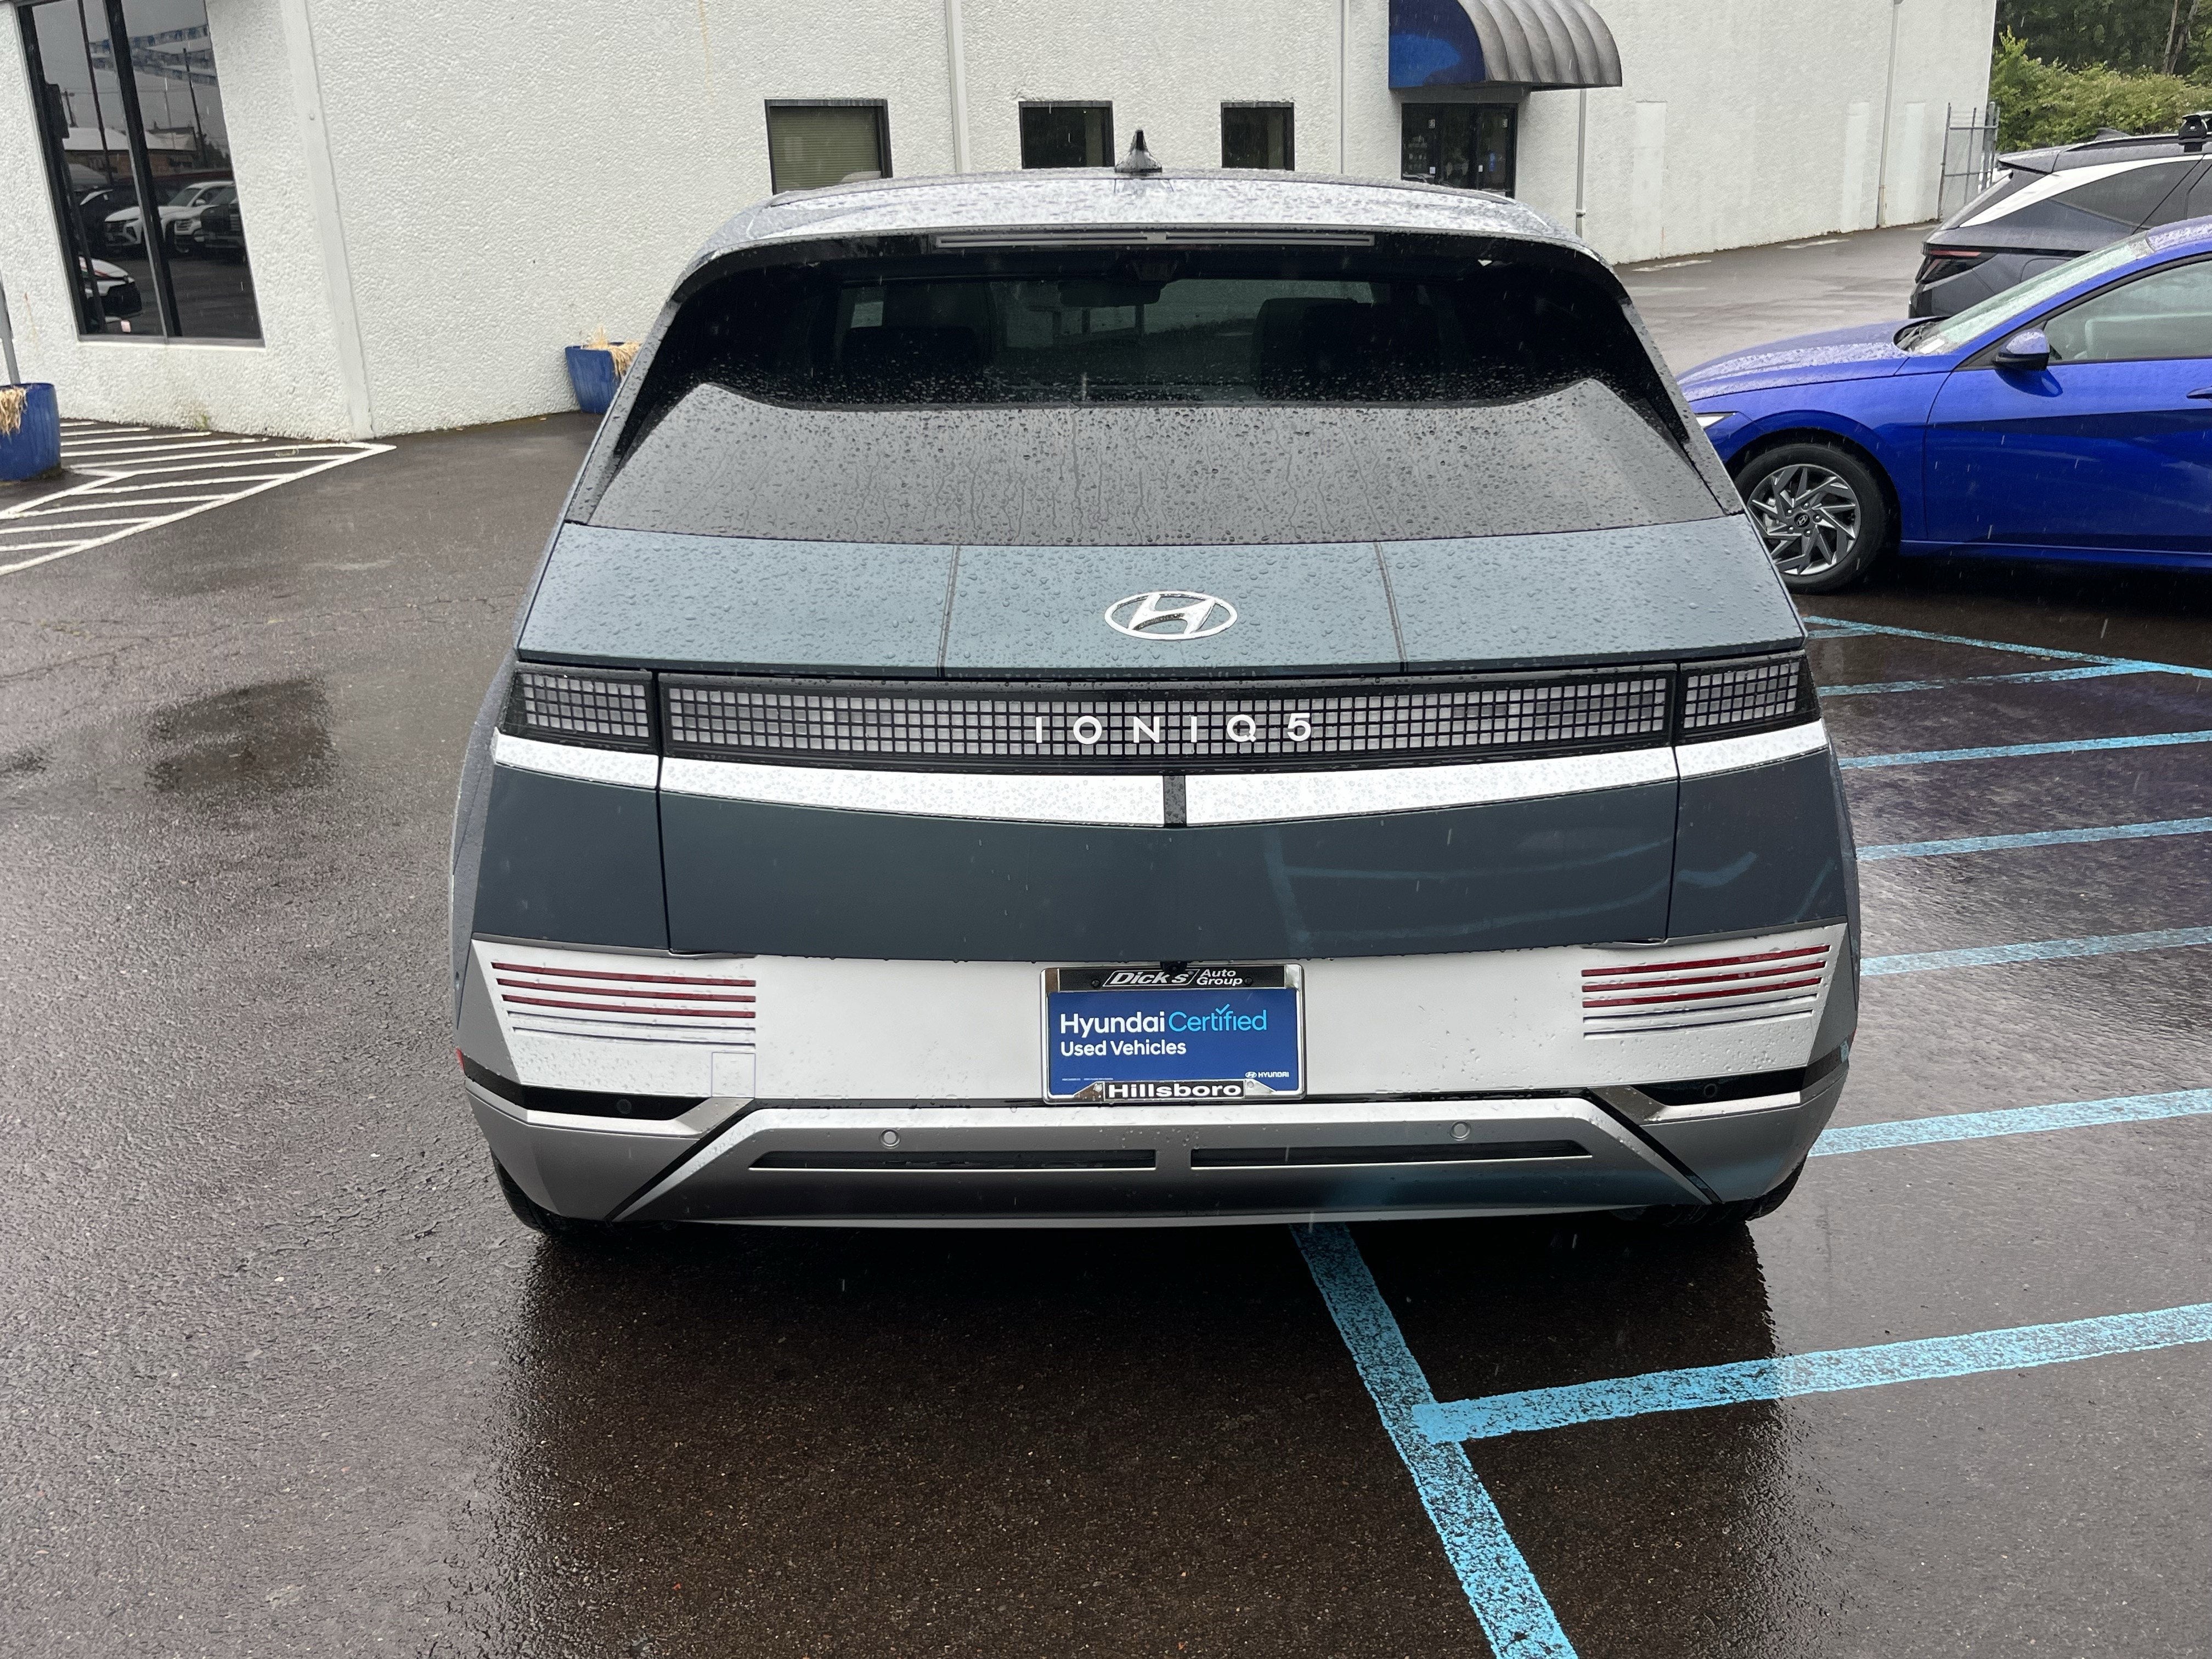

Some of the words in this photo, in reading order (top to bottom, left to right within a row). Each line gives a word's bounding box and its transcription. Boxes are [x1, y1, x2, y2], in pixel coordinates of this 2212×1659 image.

[1110, 972, 1189, 984] Dicks
[1200, 969, 1236, 977] Auto
[1197, 977, 1243, 986] Group
[1060, 1011, 1165, 1038] Hyundai
[1168, 1004, 1267, 1032] Certified
[1060, 1040, 1107, 1057] Used
[1110, 1039, 1187, 1056] Vehicles
[1108, 1083, 1242, 1098] Hillsboro
